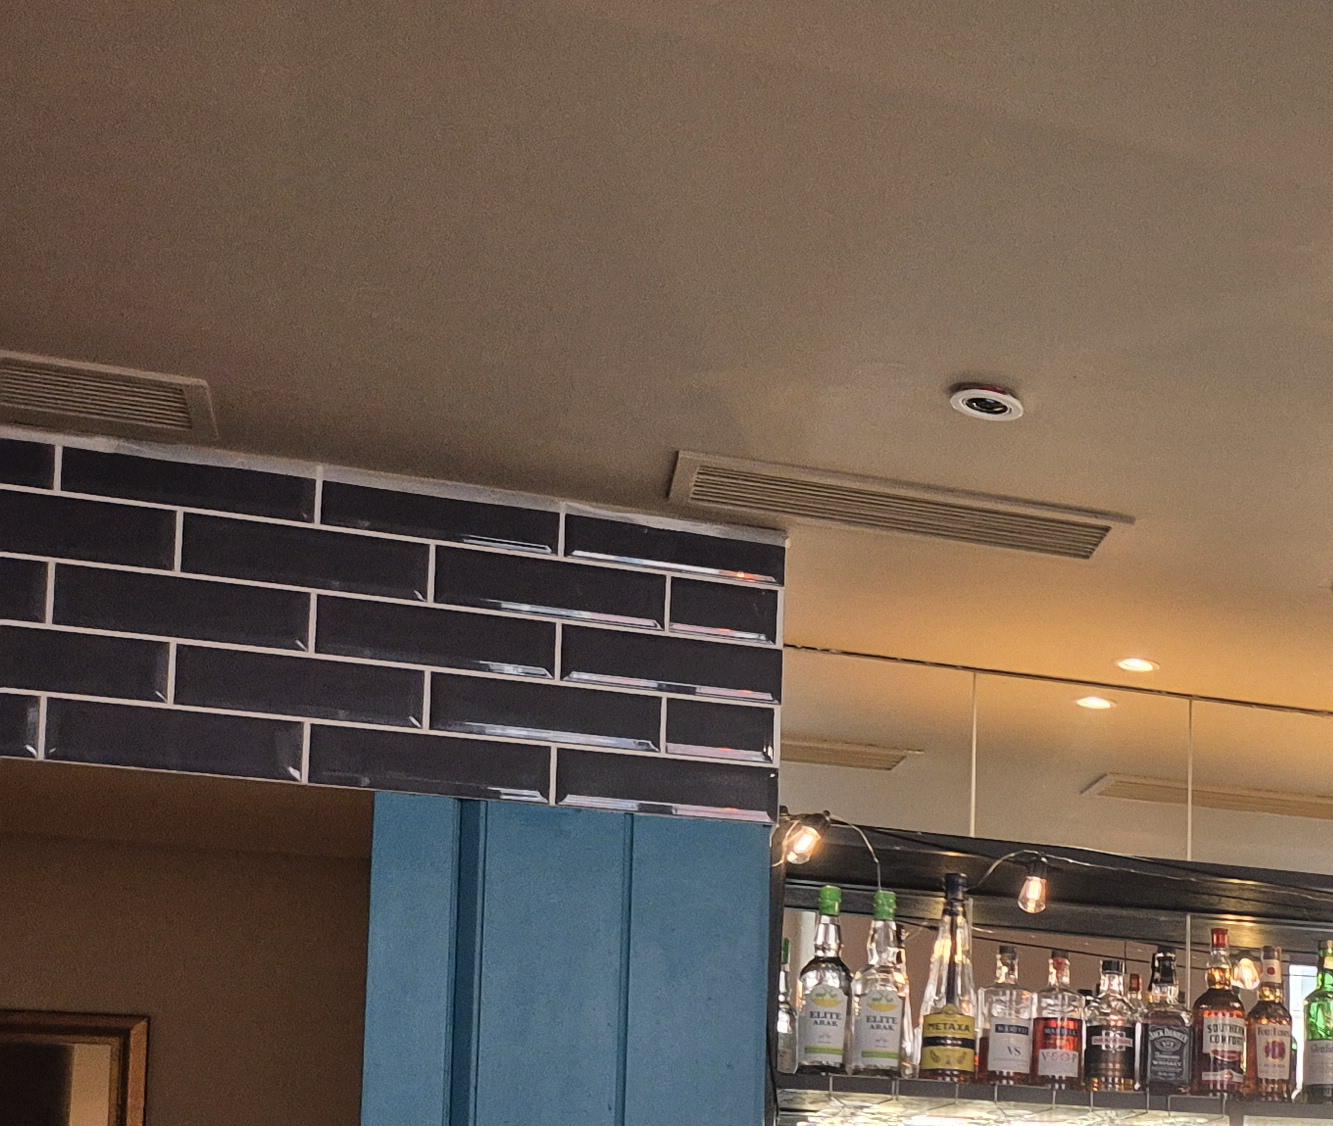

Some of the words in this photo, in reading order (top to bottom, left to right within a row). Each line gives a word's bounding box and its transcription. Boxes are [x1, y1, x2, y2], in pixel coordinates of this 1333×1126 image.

[809, 1011, 841, 1020] ELITE
[866, 1015, 898, 1024] ELITE
[927, 1023, 971, 1033] METAXA
